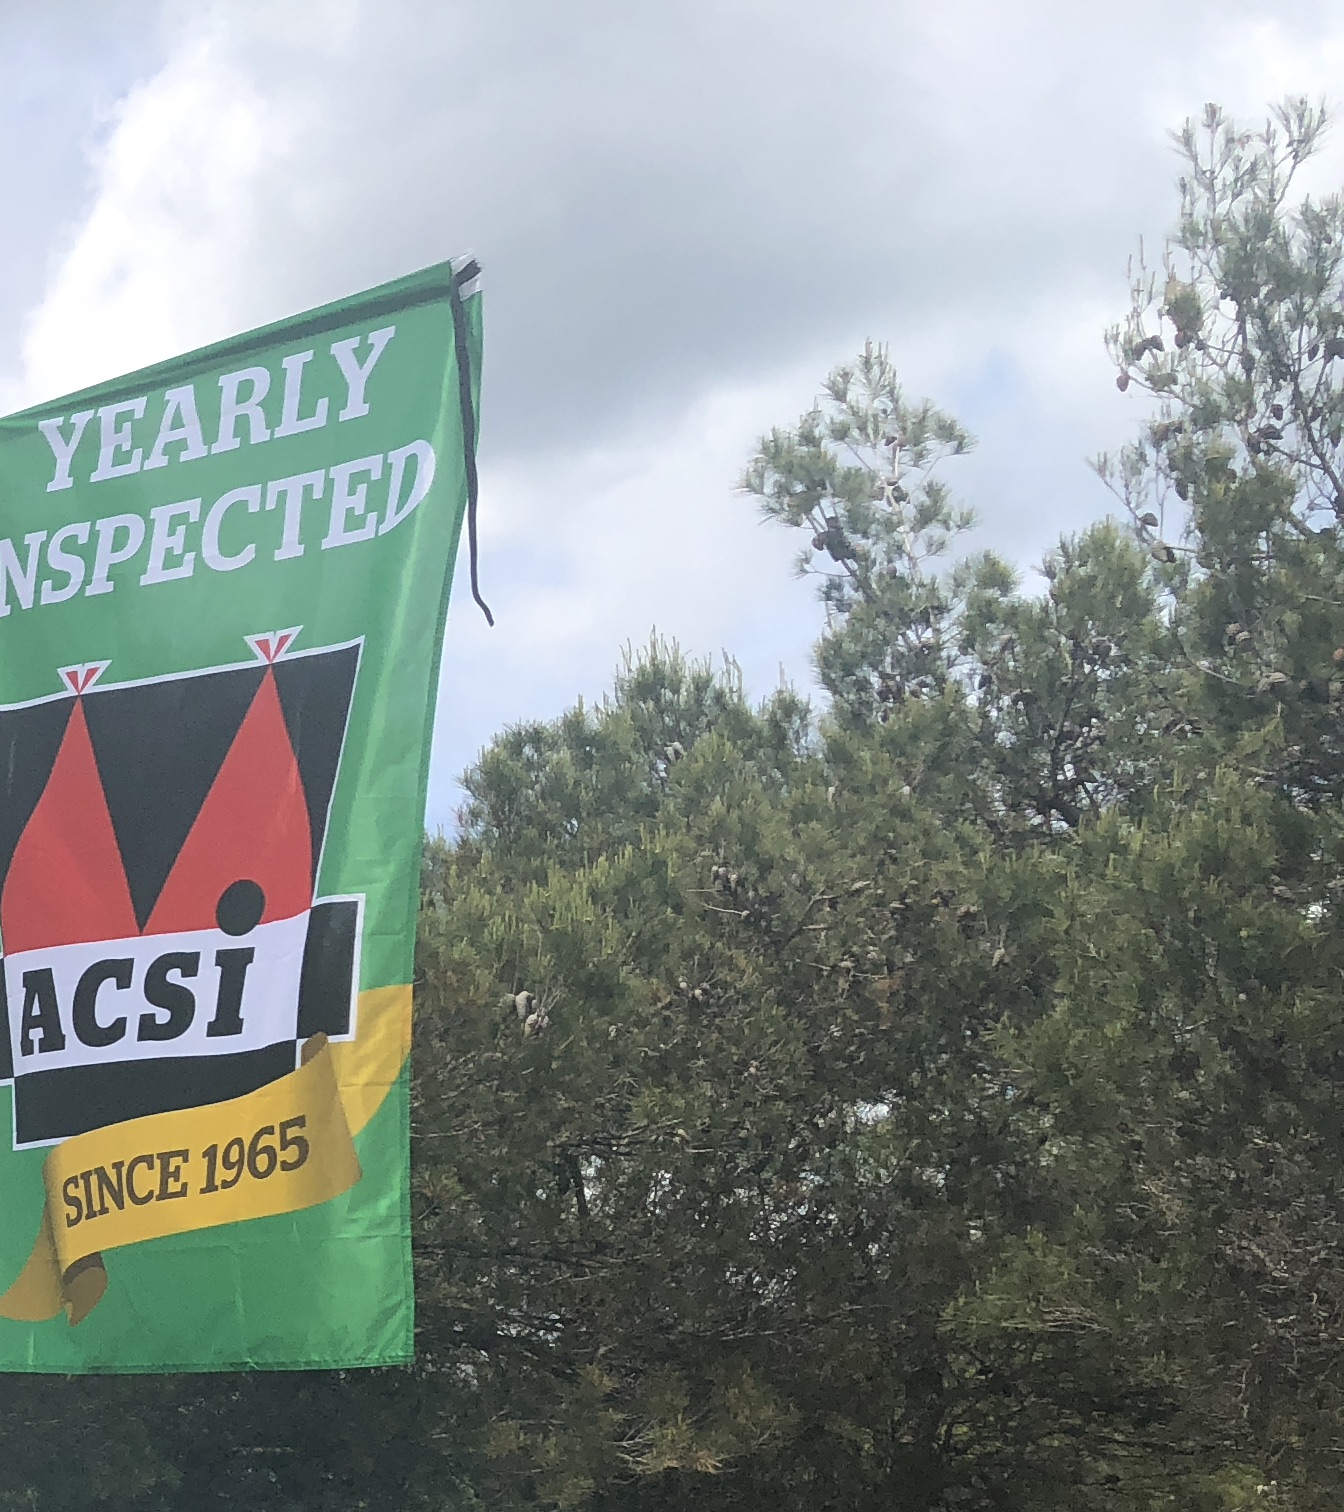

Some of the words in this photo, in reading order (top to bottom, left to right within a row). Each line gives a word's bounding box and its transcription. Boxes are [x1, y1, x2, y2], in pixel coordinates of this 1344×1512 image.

[38, 325, 396, 493] YEARLY
[62, 1147, 189, 1228] SINCE
[200, 1114, 310, 1195] 1965
